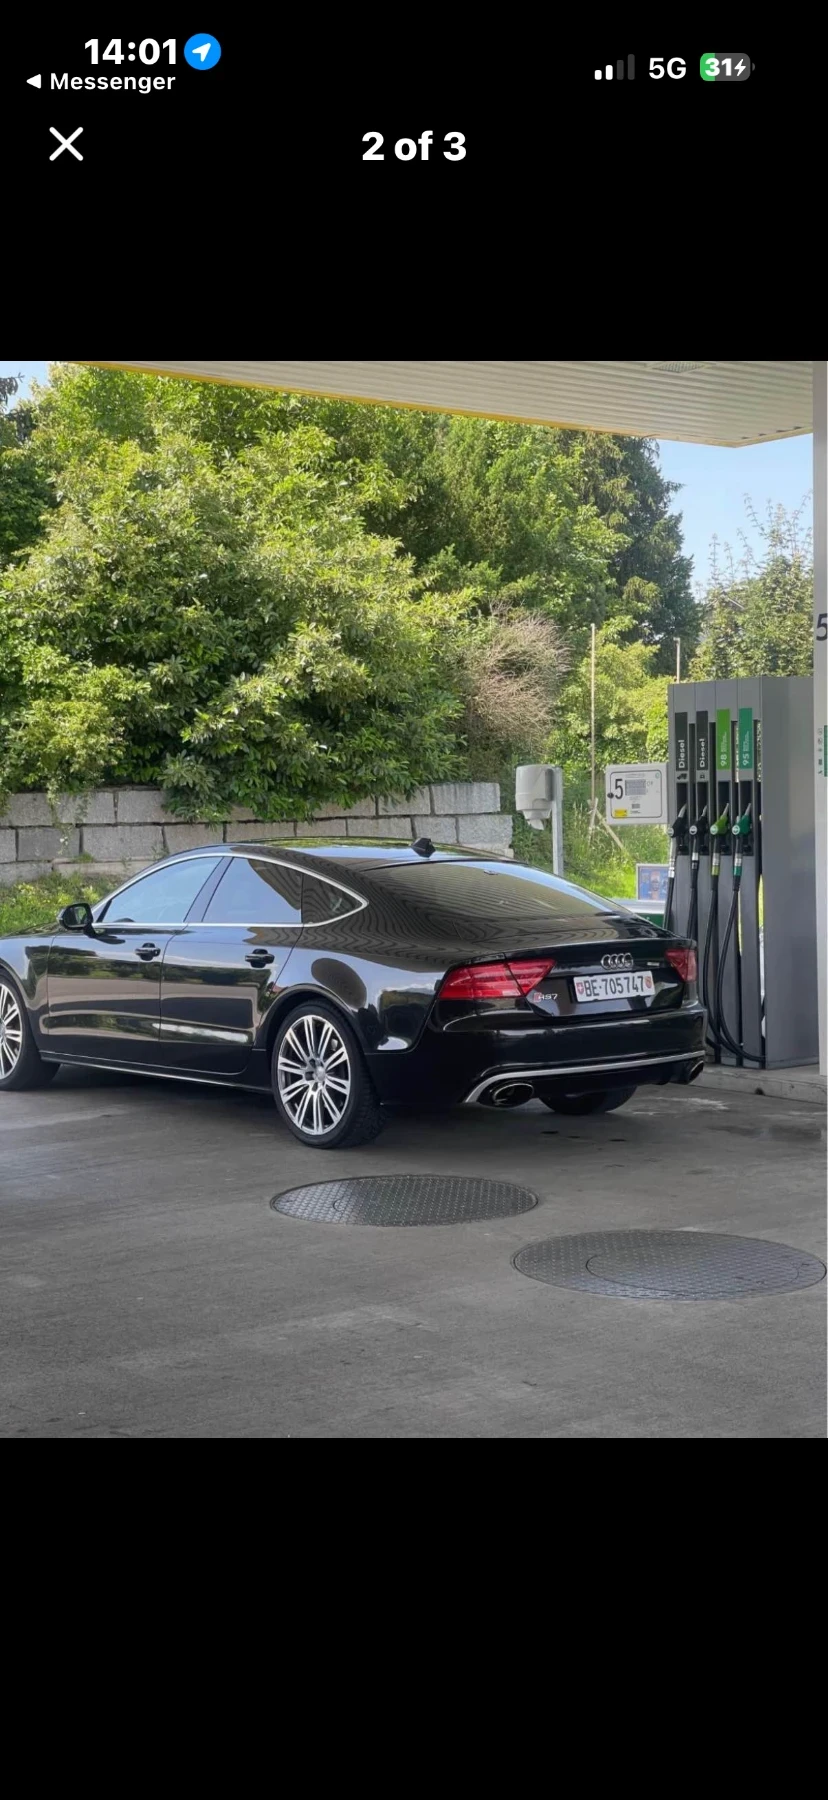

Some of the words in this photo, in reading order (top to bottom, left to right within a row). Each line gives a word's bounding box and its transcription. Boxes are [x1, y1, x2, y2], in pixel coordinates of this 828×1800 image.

[816, 612, 827, 642] 5
[678, 739, 686, 769] Diesel
[720, 753, 728, 767] 98
[742, 753, 750, 766] 95
[614, 778, 624, 800] 5
